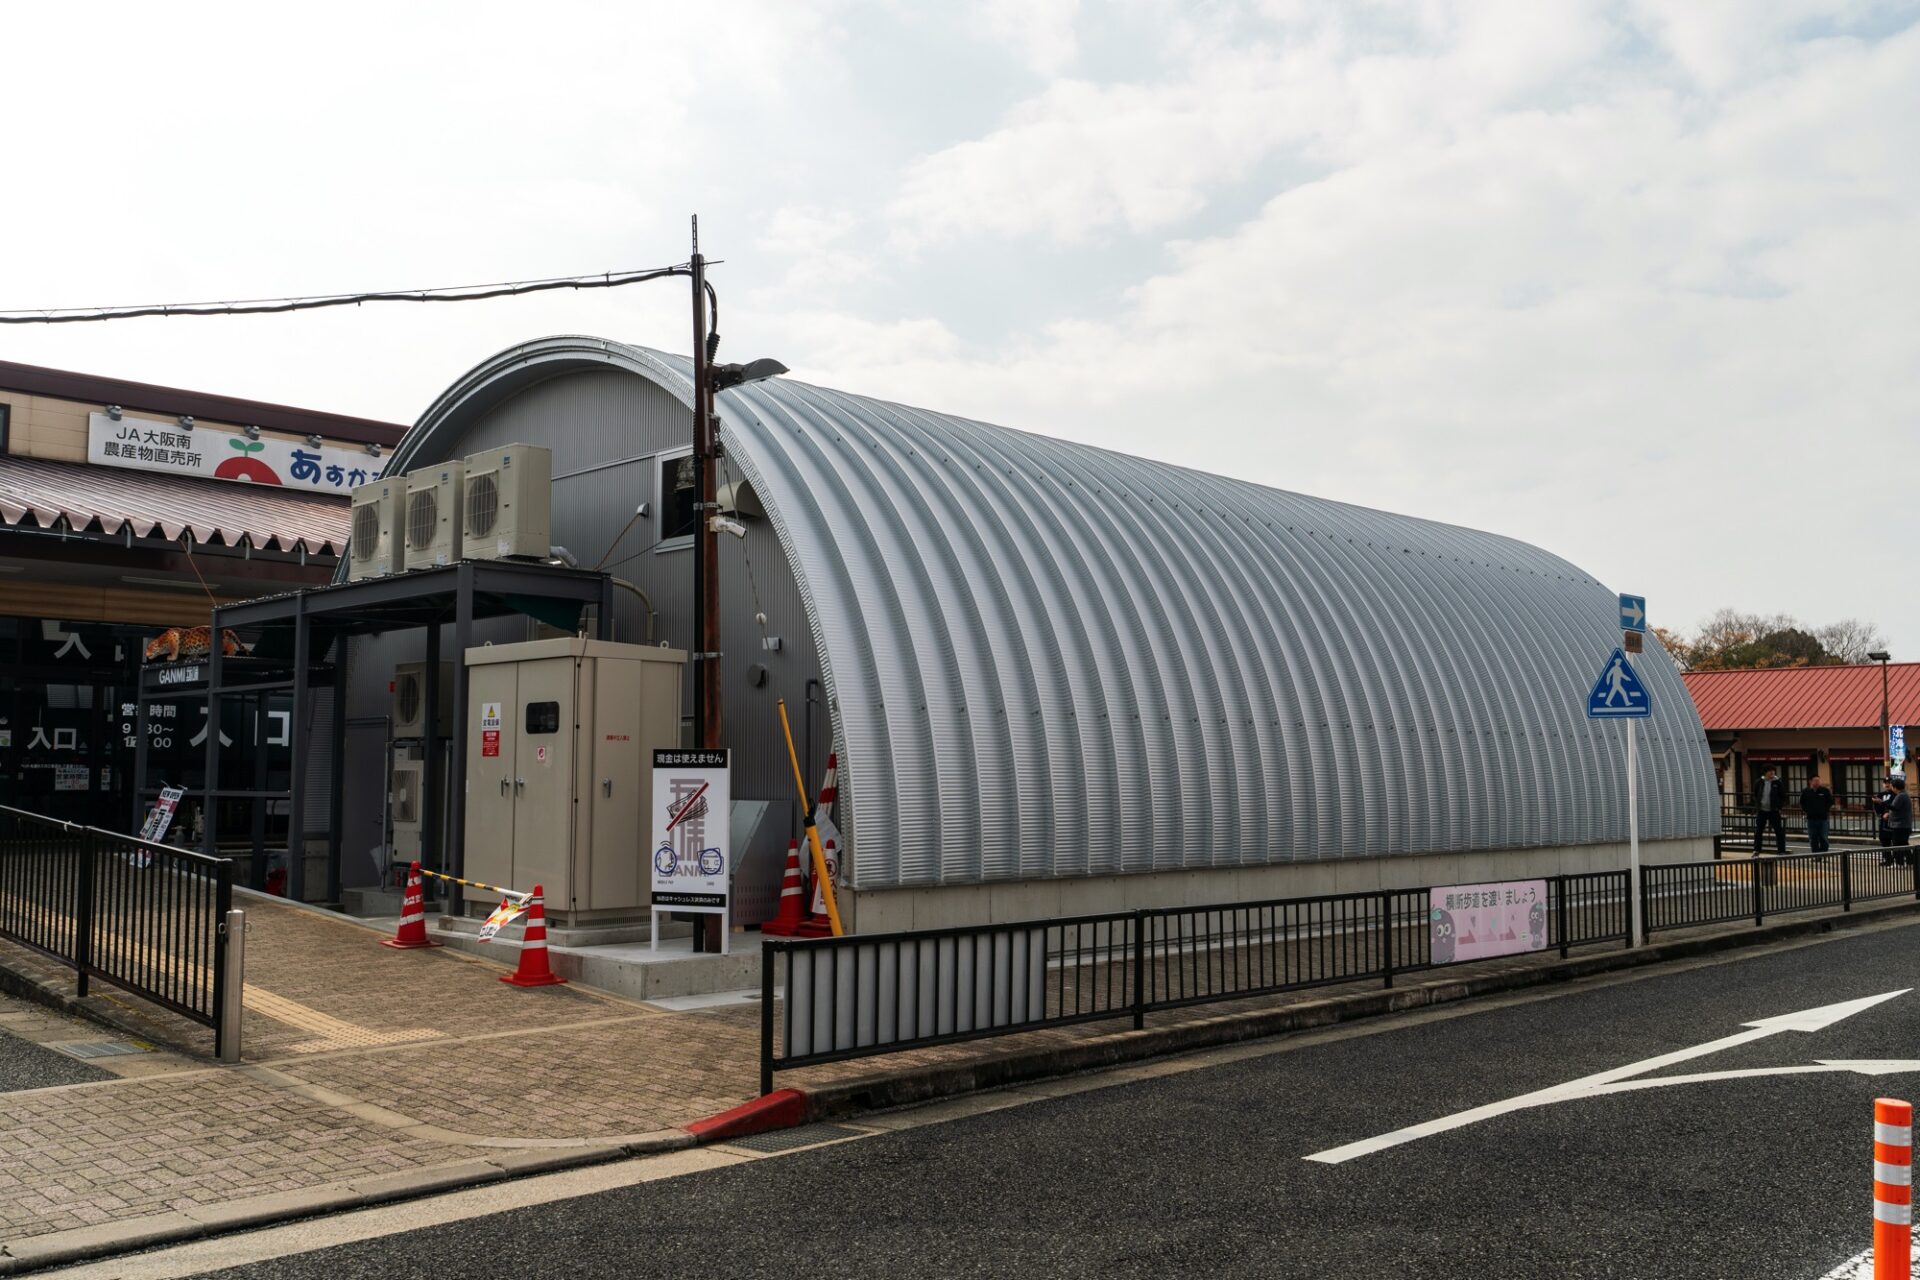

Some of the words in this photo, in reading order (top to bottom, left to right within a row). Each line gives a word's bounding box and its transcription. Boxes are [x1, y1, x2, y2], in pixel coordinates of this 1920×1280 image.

[104, 441, 202, 467] 農産物直売所
[159, 667, 185, 684] GANMI
[27, 727, 77, 750] 入口
[656, 753, 724, 764] 現金は使えません
